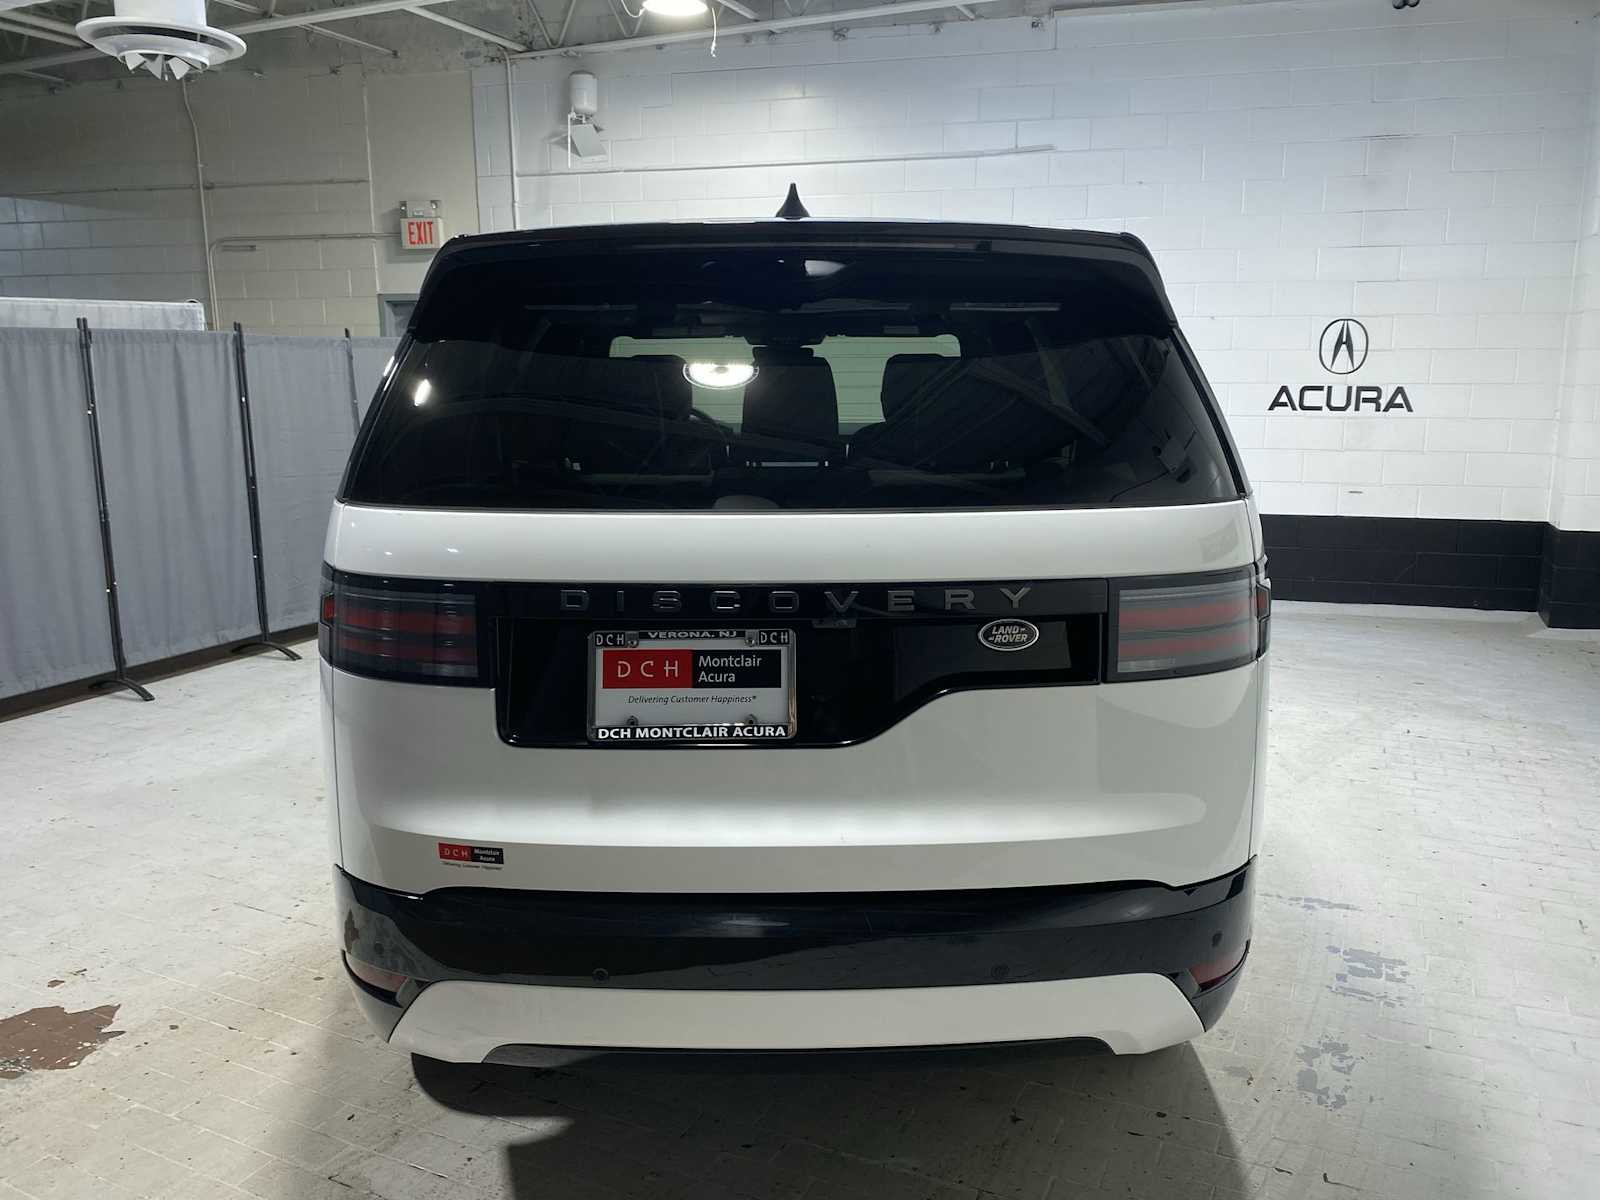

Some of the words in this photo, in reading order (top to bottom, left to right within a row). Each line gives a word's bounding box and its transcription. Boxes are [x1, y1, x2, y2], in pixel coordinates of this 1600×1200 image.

[407, 221, 433, 245] EXIT
[1267, 385, 1414, 412] ACURA
[559, 585, 1032, 614] DISCOVERY
[992, 625, 1019, 634] LAND
[596, 633, 625, 646] DCH
[760, 631, 789, 644] DCH
[994, 633, 1028, 643] ROVER
[698, 655, 763, 668] Montclair
[617, 660, 679, 678] DCH
[698, 671, 736, 683] Acura
[628, 695, 669, 706] Delivering
[670, 695, 710, 704] Customer
[598, 728, 631, 739] DCH
[635, 727, 728, 738] MONTCLAIR
[732, 726, 786, 737] ACURA
[444, 848, 469, 857] DCH
